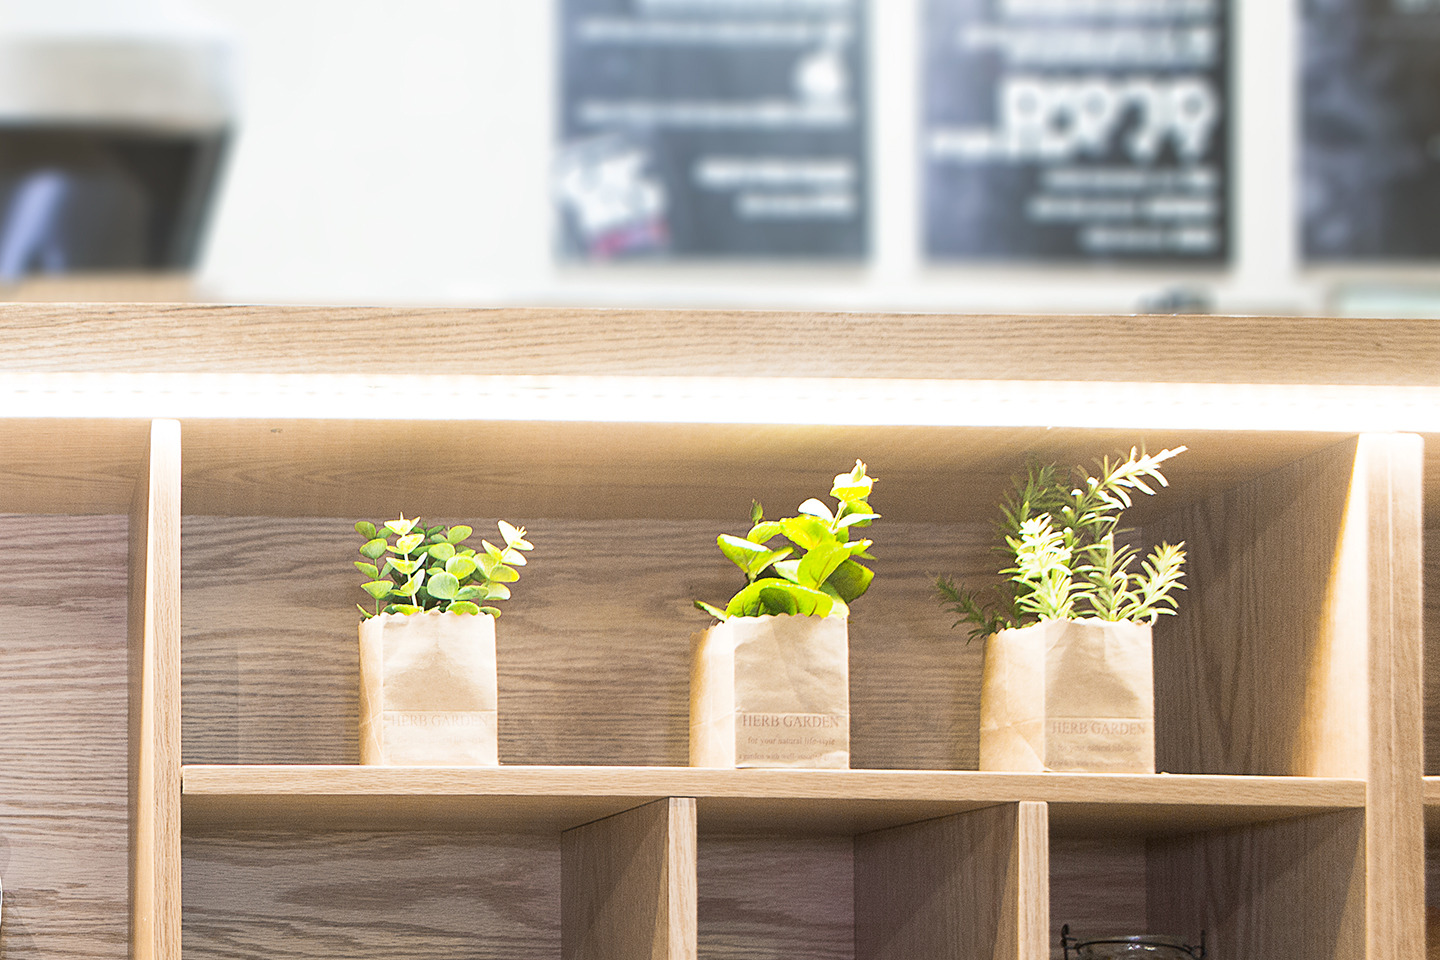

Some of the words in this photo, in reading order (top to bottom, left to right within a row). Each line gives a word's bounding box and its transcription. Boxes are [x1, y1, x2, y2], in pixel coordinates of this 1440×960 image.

[391, 714, 427, 727] HERB
[431, 714, 488, 727] GARDEN
[742, 714, 779, 727] HERB
[783, 714, 839, 728] GARDEN
[1052, 721, 1088, 734] HERB
[1091, 722, 1146, 735] GARDEN
[778, 737, 802, 745] natural
